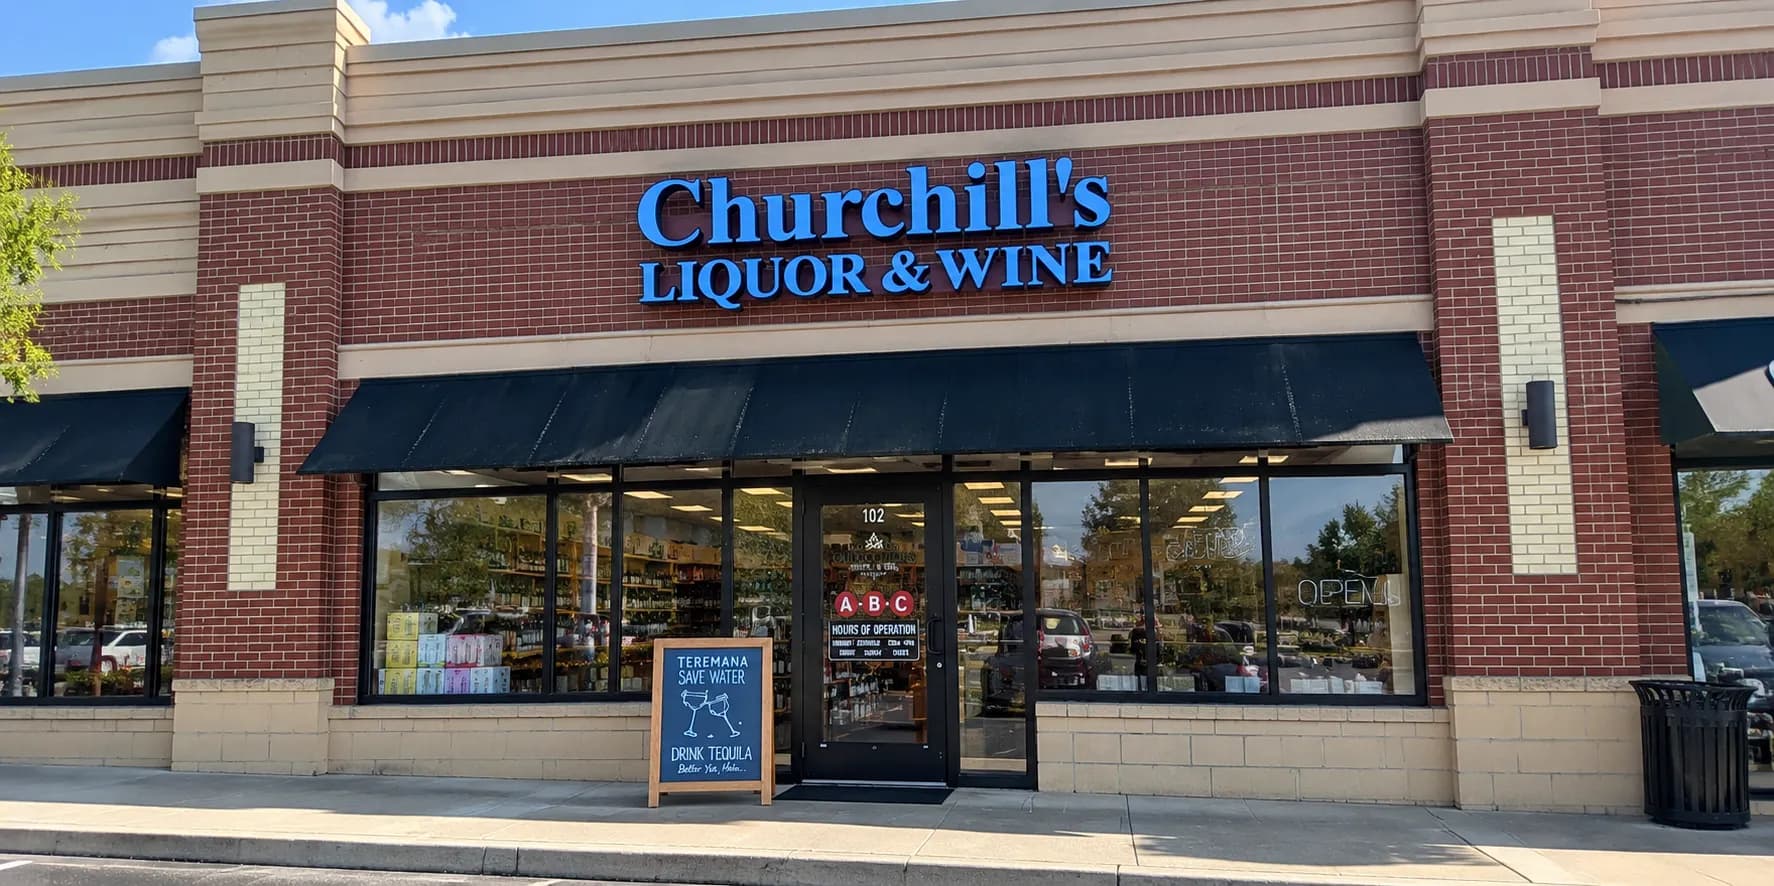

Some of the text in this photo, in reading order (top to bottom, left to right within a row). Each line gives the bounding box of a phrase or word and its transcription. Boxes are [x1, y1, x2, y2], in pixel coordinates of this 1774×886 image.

[636, 156, 1113, 250] Churchill's
[639, 239, 1115, 311] LIQUOR & WINE
[862, 508, 885, 523] 102
[832, 624, 916, 635] HOURS OF OPERATION
[677, 656, 749, 668] TEREMANA
[678, 669, 746, 685] SAVE WATER
[671, 746, 753, 762] DRINK TEQUILA
